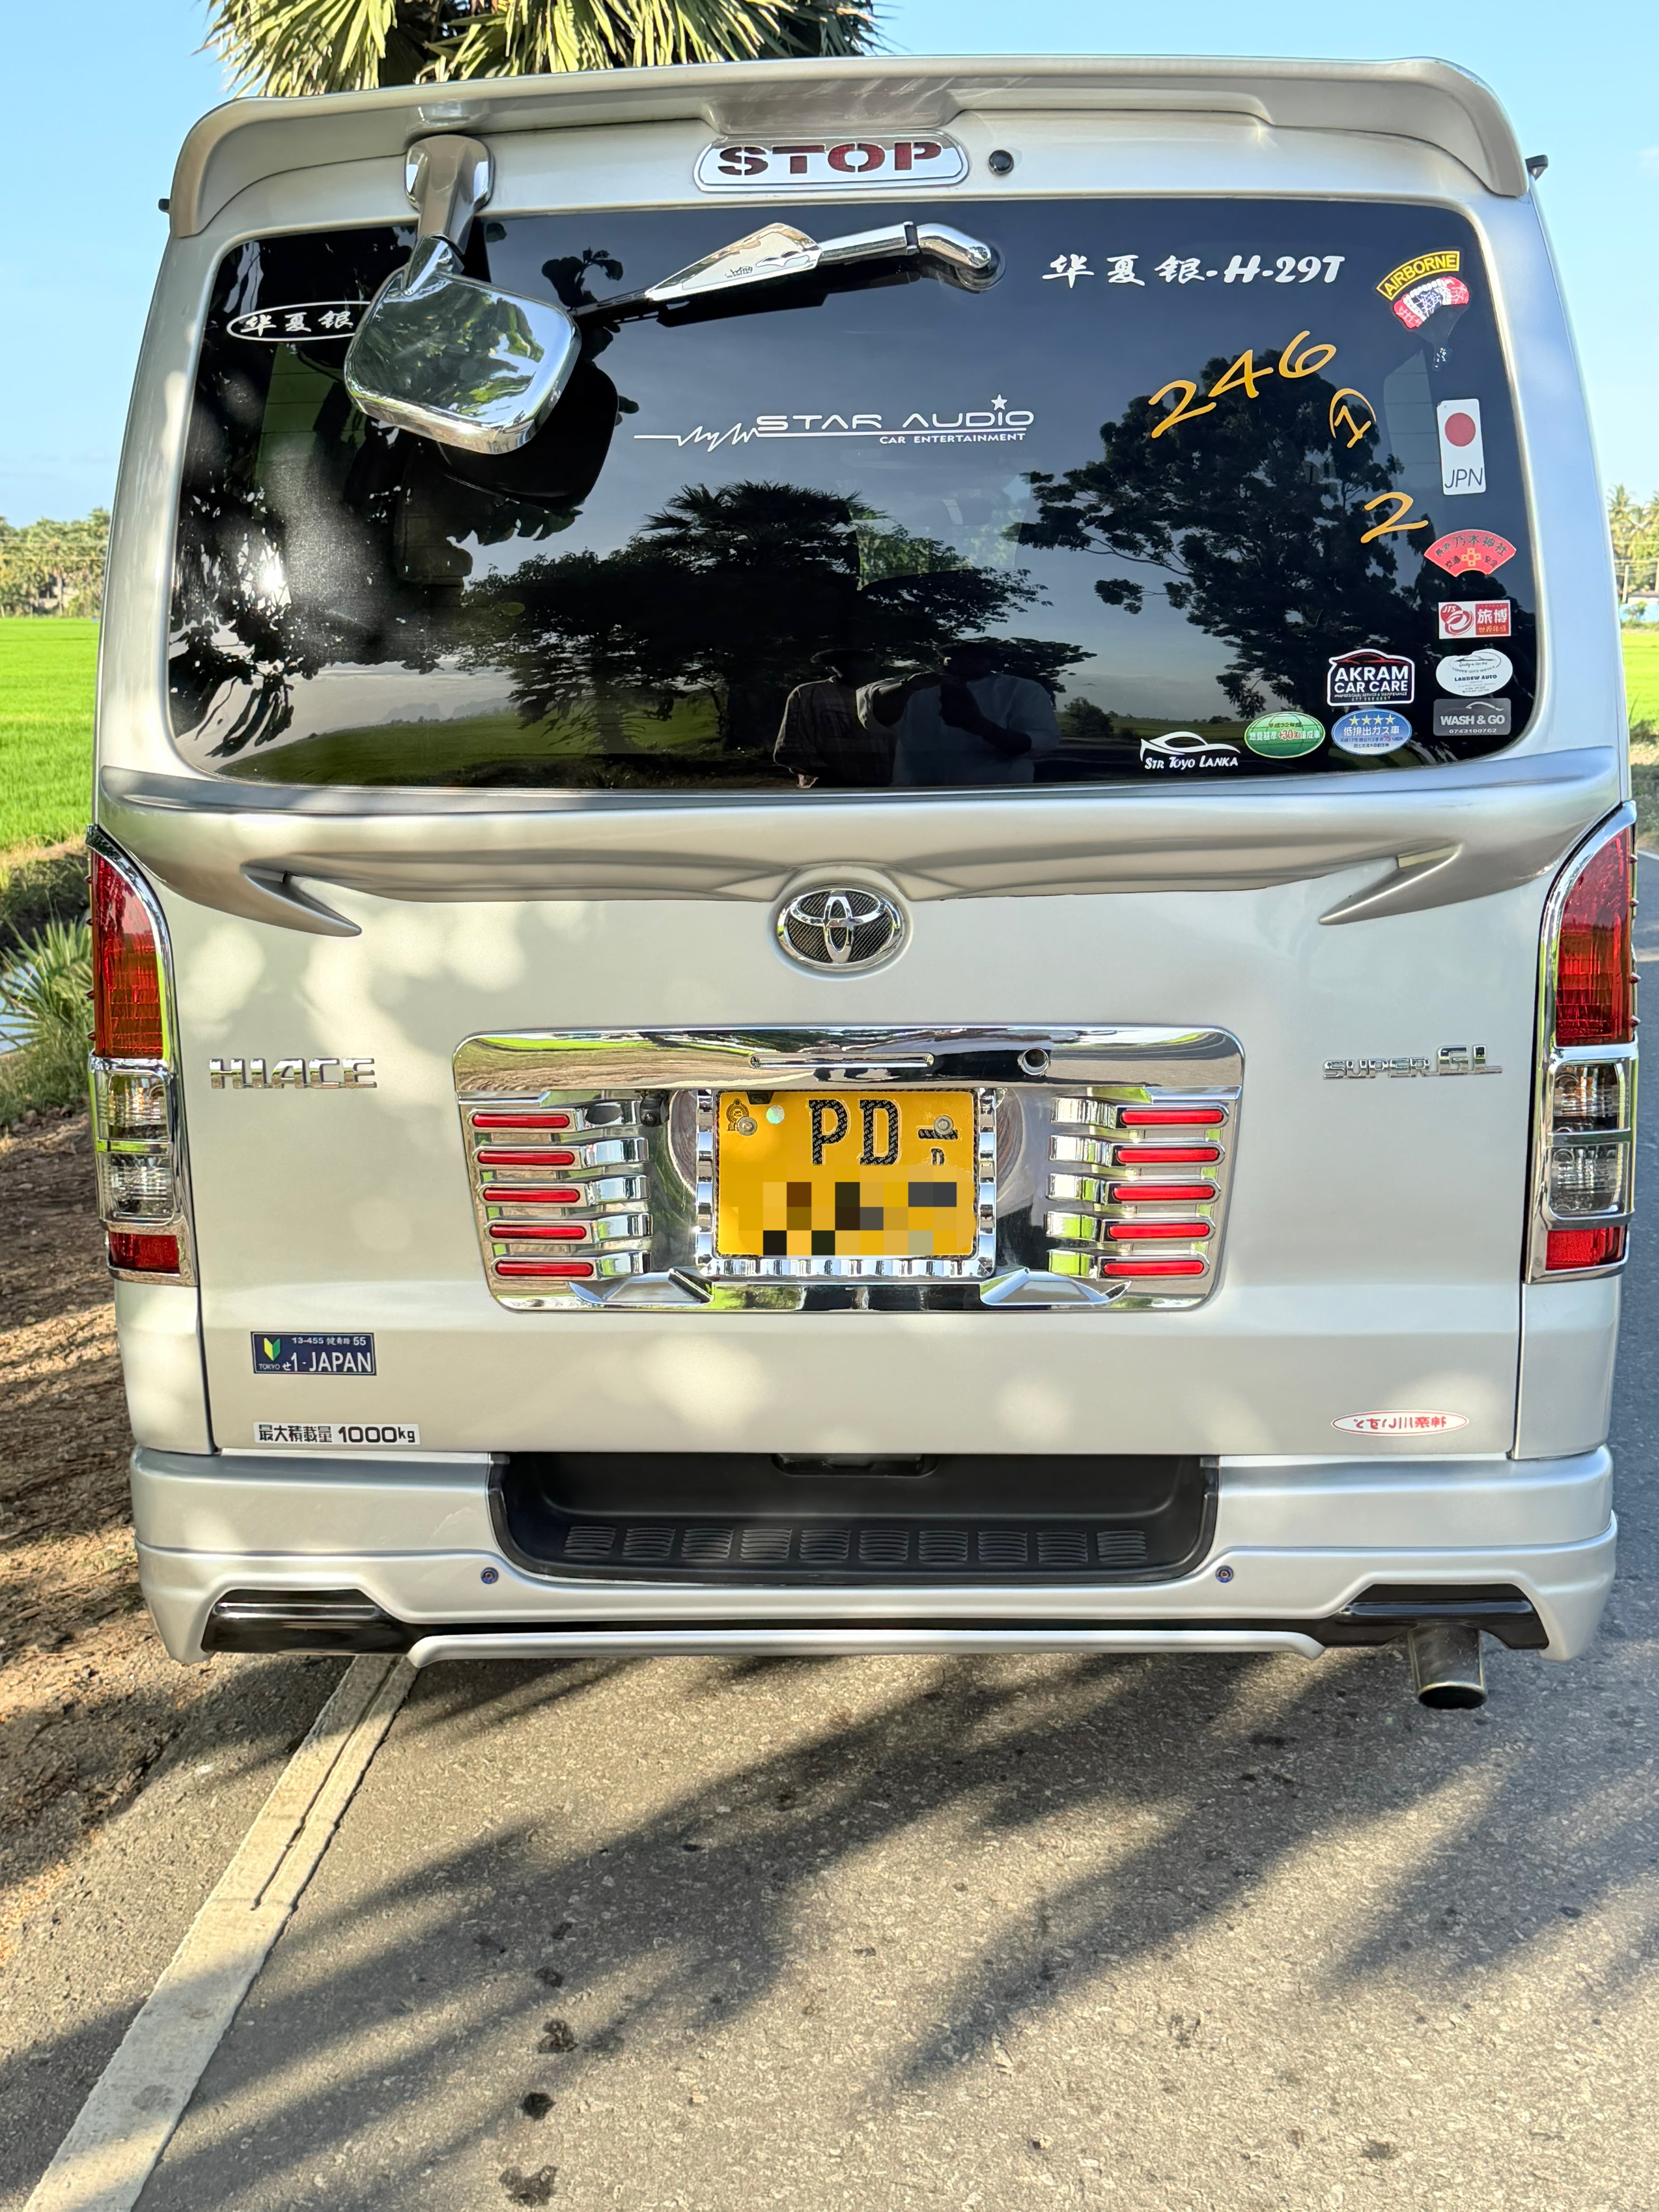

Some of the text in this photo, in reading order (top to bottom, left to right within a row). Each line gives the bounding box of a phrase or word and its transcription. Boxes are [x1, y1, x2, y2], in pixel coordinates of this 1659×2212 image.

[717, 141, 942, 176] STOP
[1383, 254, 1457, 296] AIRBORNE
[756, 405, 1034, 430] STAR AUDIO
[879, 433, 1026, 445] CAR ENTERTAINMENT
[1444, 467, 1483, 488] JPN
[1477, 608, 1507, 624] 旅博
[1335, 666, 1409, 682] AKRAM
[1334, 681, 1408, 693] CAR CARE
[1440, 715, 1505, 726] WASH & GO
[1323, 1044, 1503, 1080] SUPER GL
[210, 1057, 377, 1089] HIACE
[258, 1424, 333, 1443] 最大積載量
